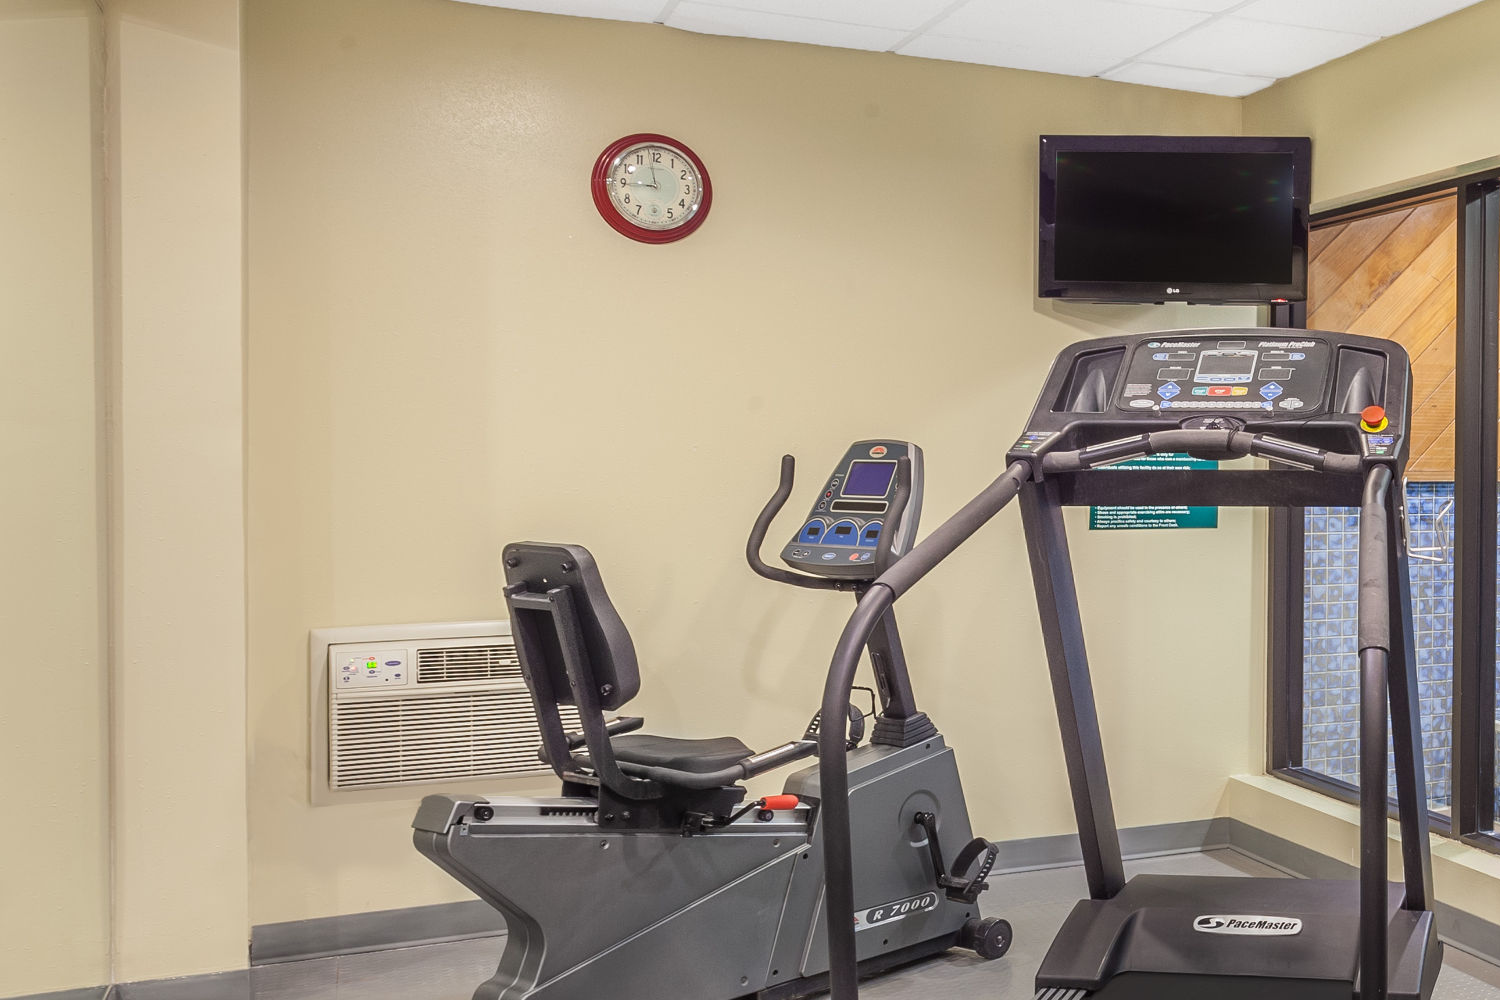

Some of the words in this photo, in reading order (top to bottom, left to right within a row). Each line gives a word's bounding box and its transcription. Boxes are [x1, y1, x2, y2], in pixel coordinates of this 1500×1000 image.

[636, 154, 644, 166] 11
[652, 152, 662, 163] 12
[670, 158, 674, 168] 1
[680, 170, 686, 180] 2
[620, 178, 626, 188] 9
[684, 184, 690, 195] 3
[624, 193, 630, 204] 8
[678, 198, 685, 208] 4
[636, 204, 642, 215] 7
[667, 208, 673, 218] 5
[873, 909, 884, 921] R
[890, 896, 930, 916] 7000
[1226, 919, 1298, 930] PaceMaster
